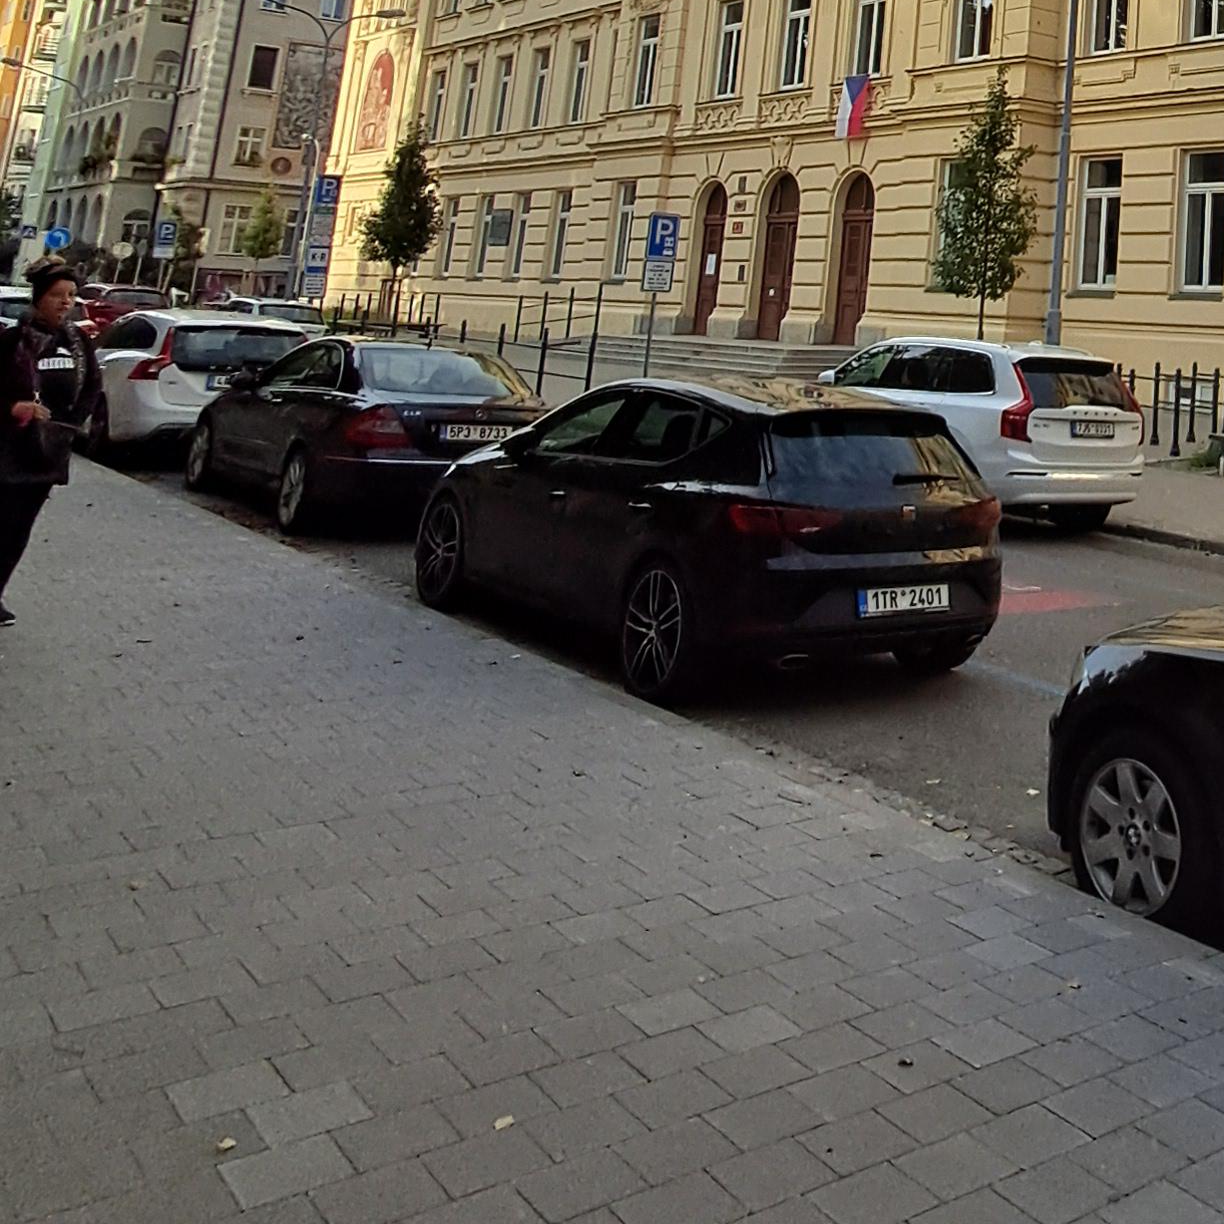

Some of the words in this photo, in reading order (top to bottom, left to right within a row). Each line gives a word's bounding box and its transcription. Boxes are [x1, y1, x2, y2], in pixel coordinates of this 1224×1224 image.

[321, 178, 337, 196] P
[160, 224, 175, 238] P
[655, 218, 674, 245] P
[479, 427, 507, 439] 8733
[872, 590, 898, 609] 1TR
[909, 587, 942, 607] 2401
